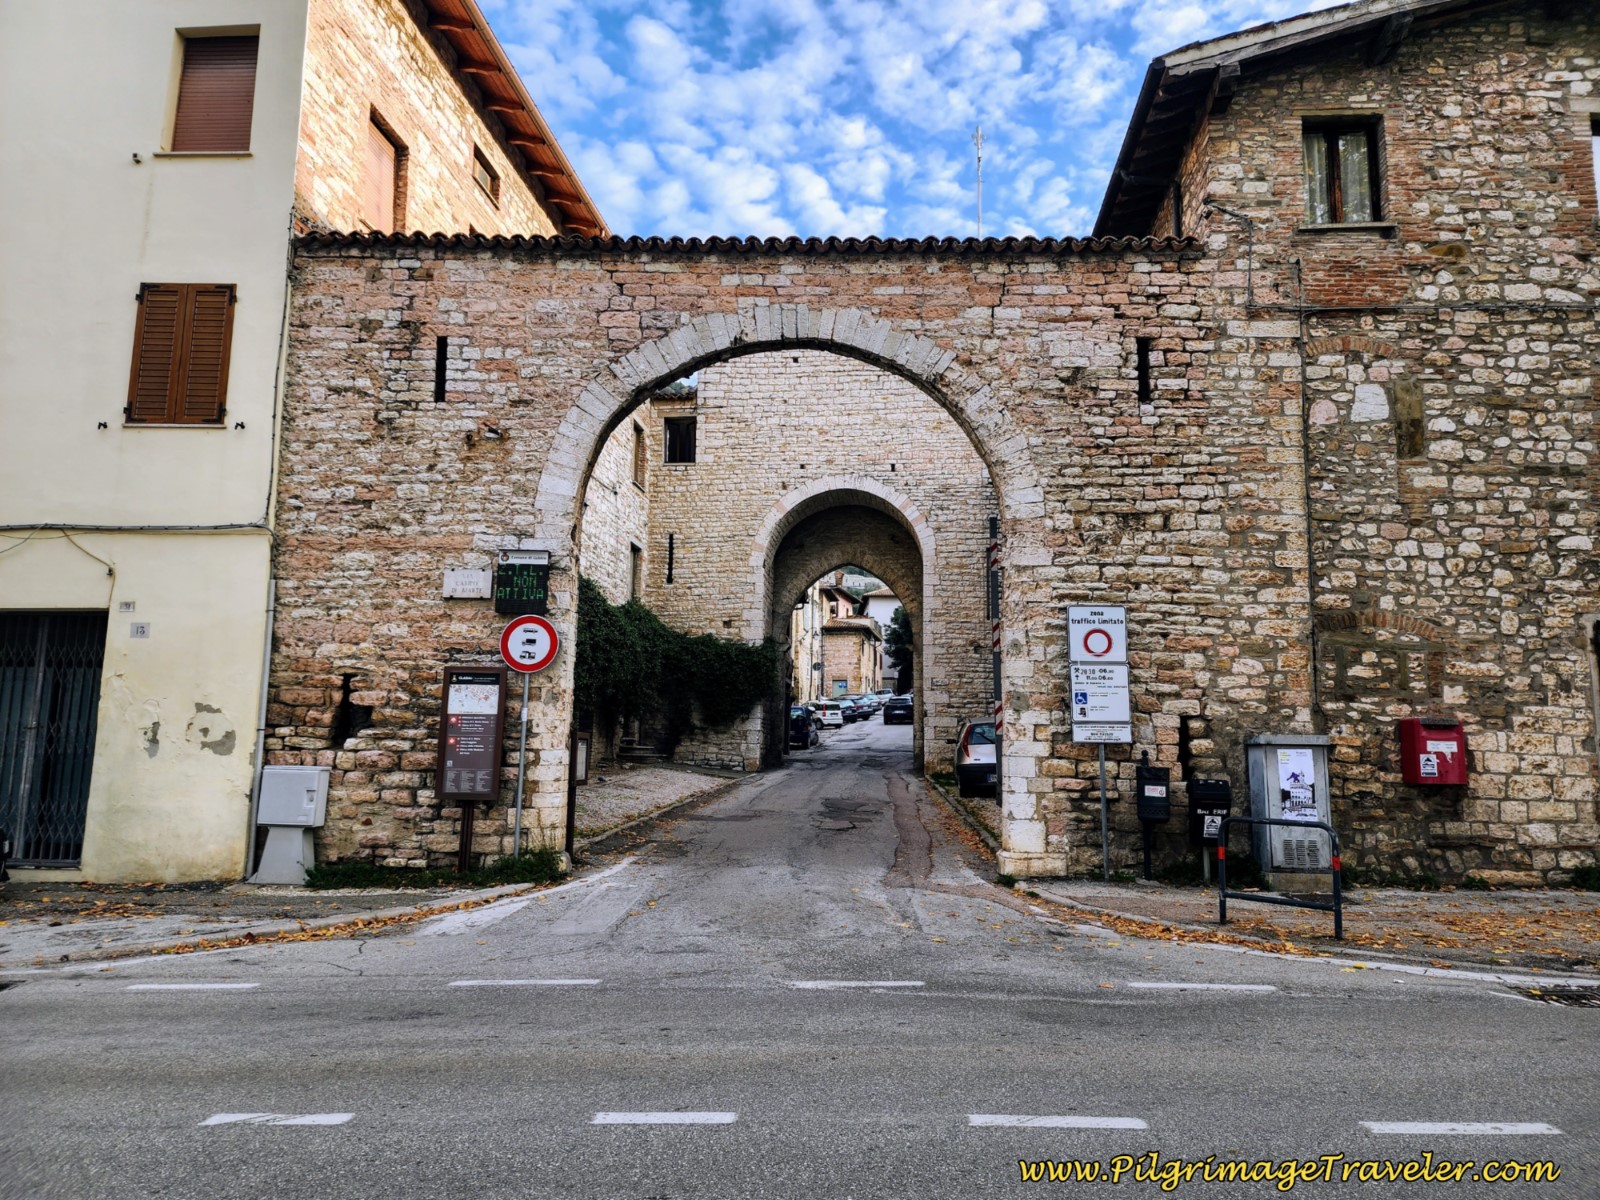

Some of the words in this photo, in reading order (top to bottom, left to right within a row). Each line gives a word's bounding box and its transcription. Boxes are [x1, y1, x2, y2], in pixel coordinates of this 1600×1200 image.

[513, 576, 537, 588] NON
[497, 587, 544, 600] ATTIVA
[1071, 617, 1096, 625] traffico
[1098, 617, 1124, 625] limitato
